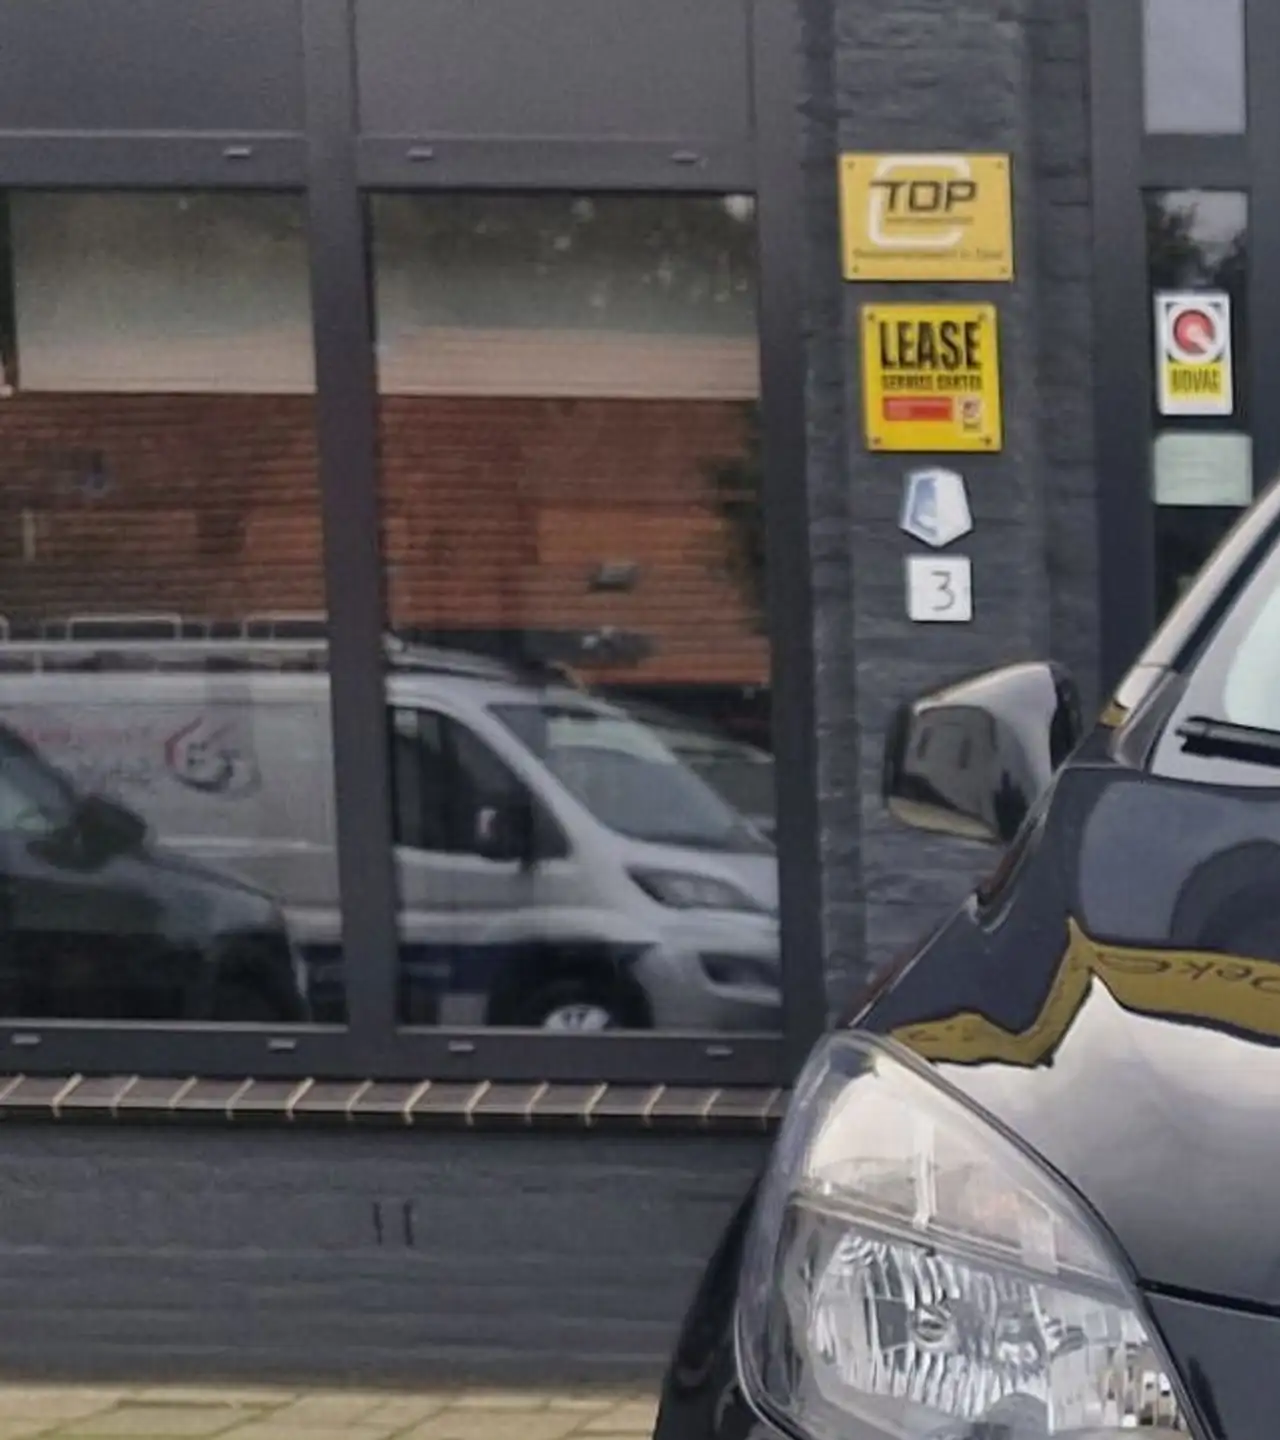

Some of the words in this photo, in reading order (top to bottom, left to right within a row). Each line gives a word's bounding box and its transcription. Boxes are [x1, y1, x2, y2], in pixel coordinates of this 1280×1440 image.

[869, 180, 977, 212] TOP
[880, 320, 982, 370] LEASE
[930, 571, 957, 611] 3
